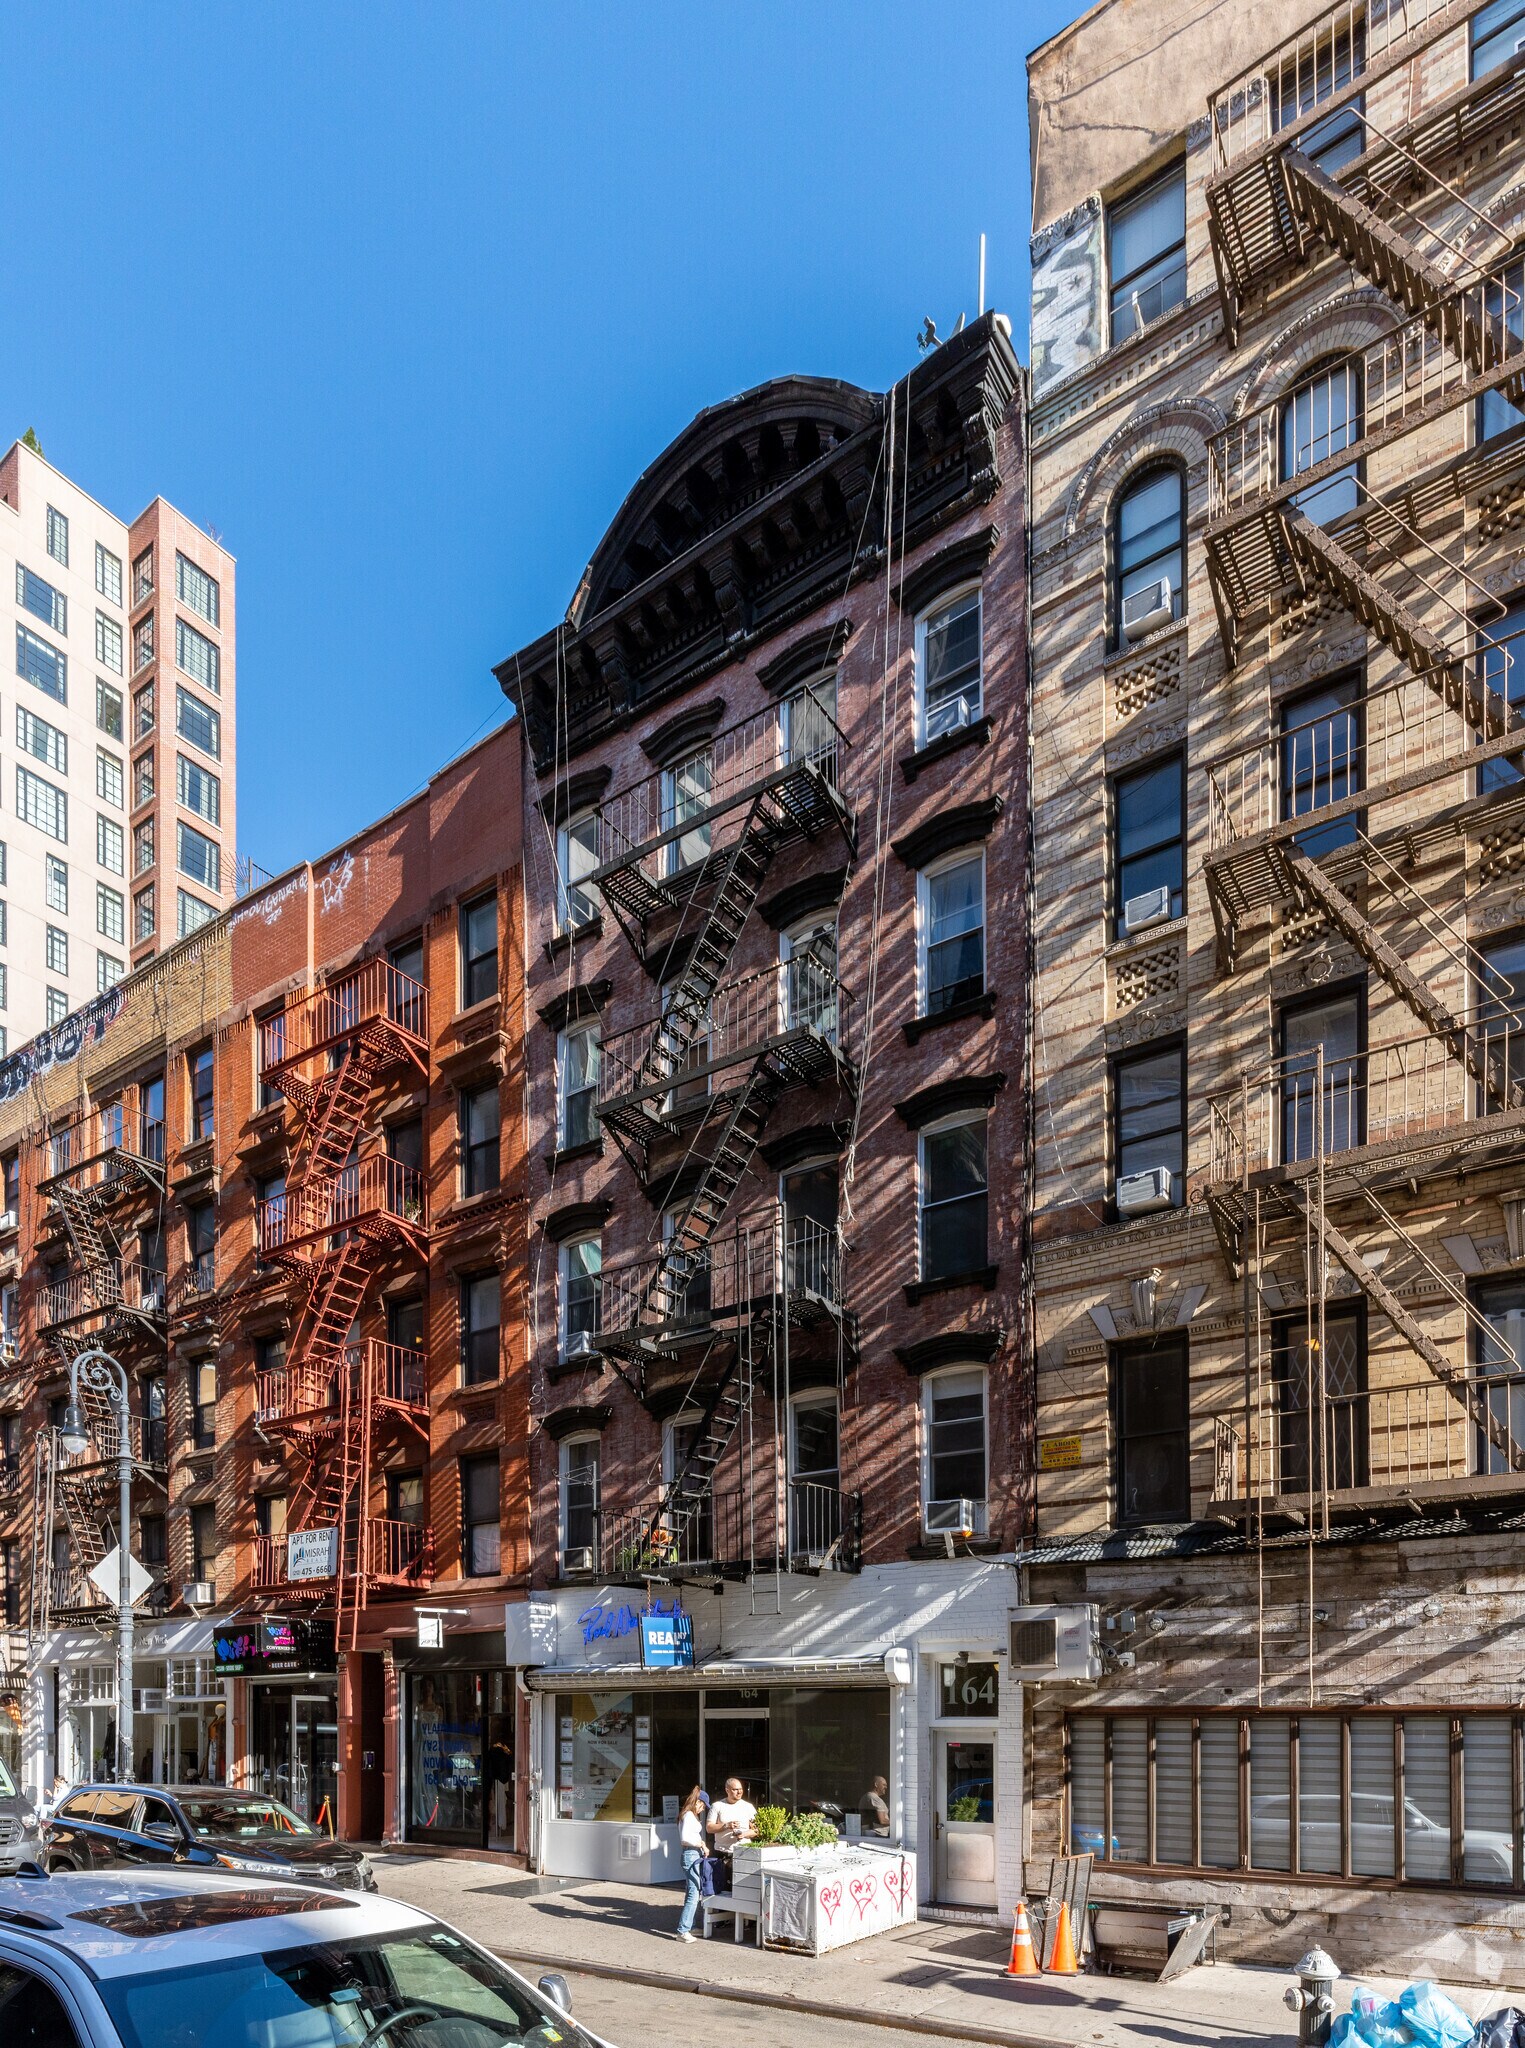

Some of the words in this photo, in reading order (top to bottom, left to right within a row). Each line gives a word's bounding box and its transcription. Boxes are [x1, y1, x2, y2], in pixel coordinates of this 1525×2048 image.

[306, 1533, 317, 1543] FOR
[319, 1531, 334, 1542] RENT
[305, 1546, 332, 1558] MISRAHI
[740, 1688, 758, 1699] 164
[945, 1675, 996, 1705] 164
